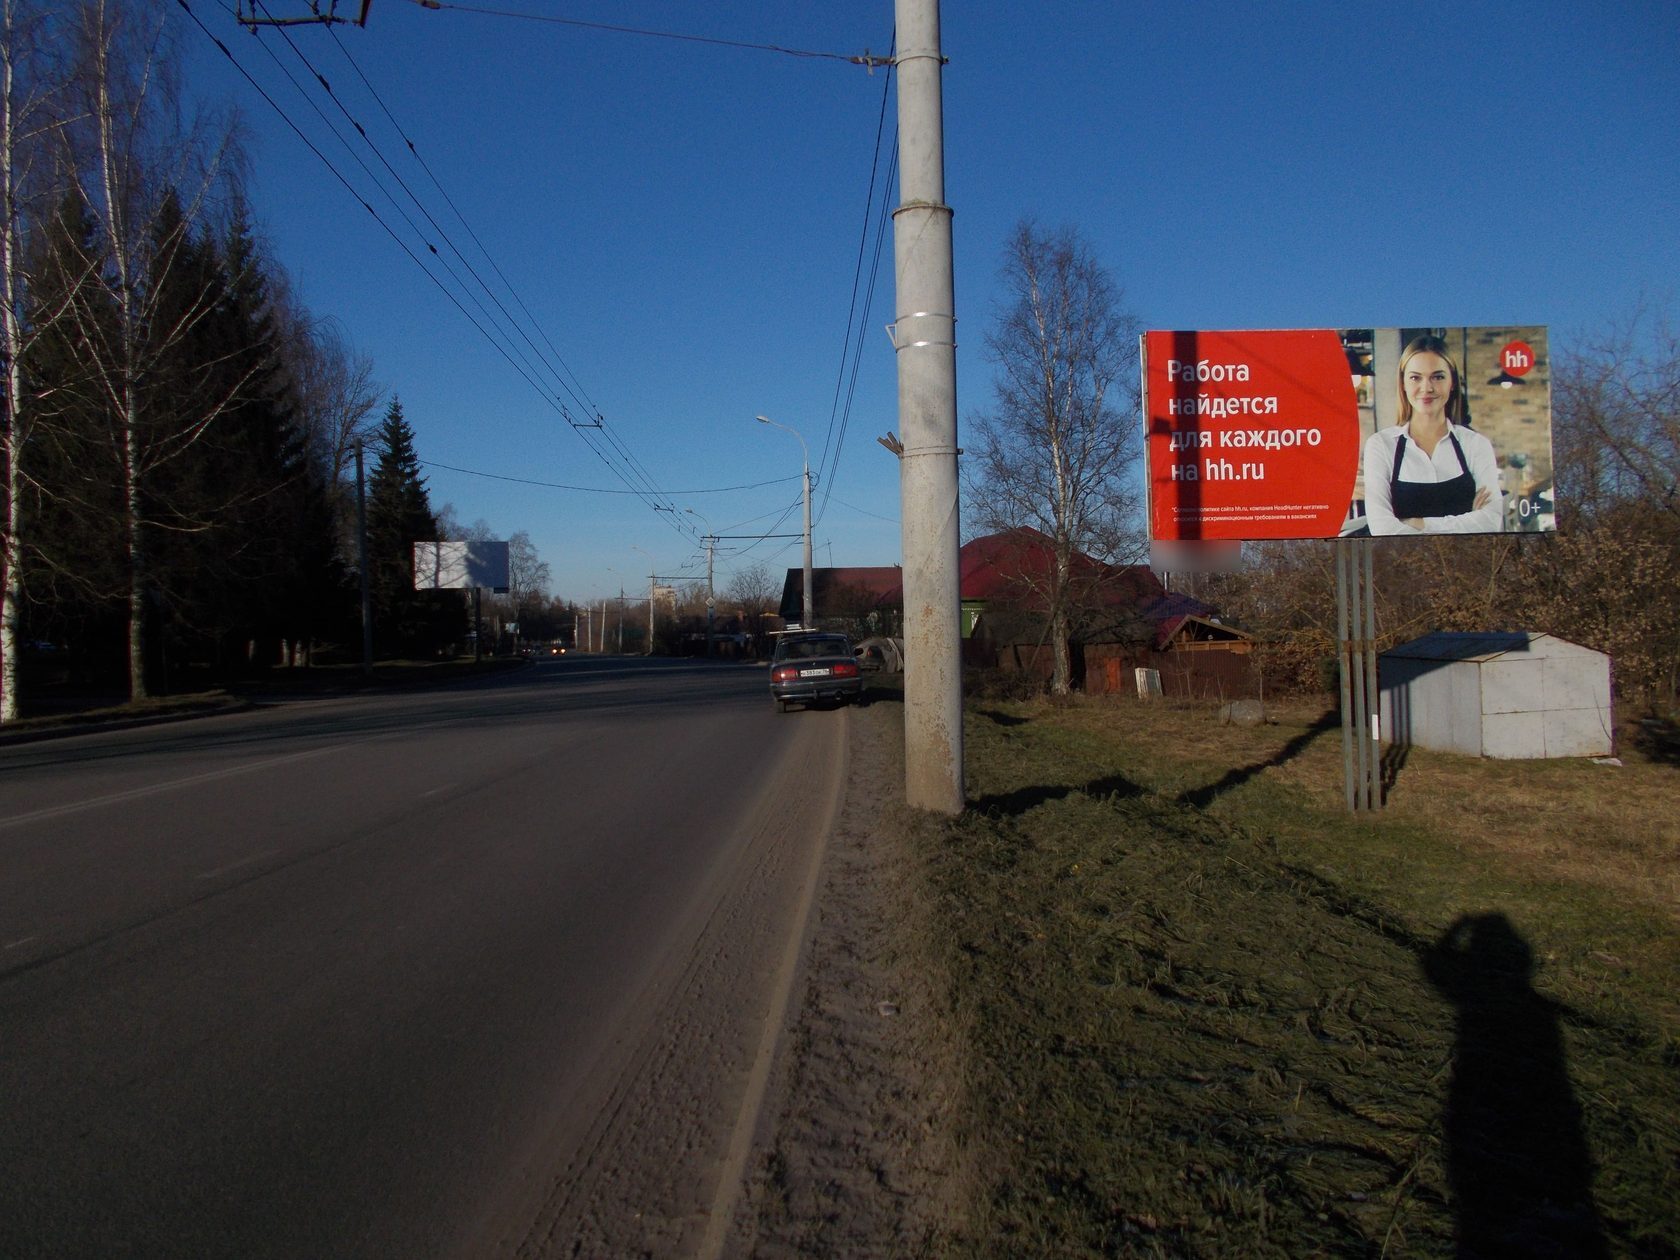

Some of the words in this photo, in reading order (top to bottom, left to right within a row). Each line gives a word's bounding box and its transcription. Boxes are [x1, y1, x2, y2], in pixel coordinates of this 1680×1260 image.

[1167, 359, 1250, 382] Работа
[1505, 350, 1528, 368] hh
[1168, 393, 1278, 418] найдется
[1169, 431, 1212, 452] для
[1219, 428, 1322, 451] каждого
[1171, 463, 1198, 481] на
[1205, 458, 1265, 481] hh.ru
[1519, 498, 1541, 517] 0+
